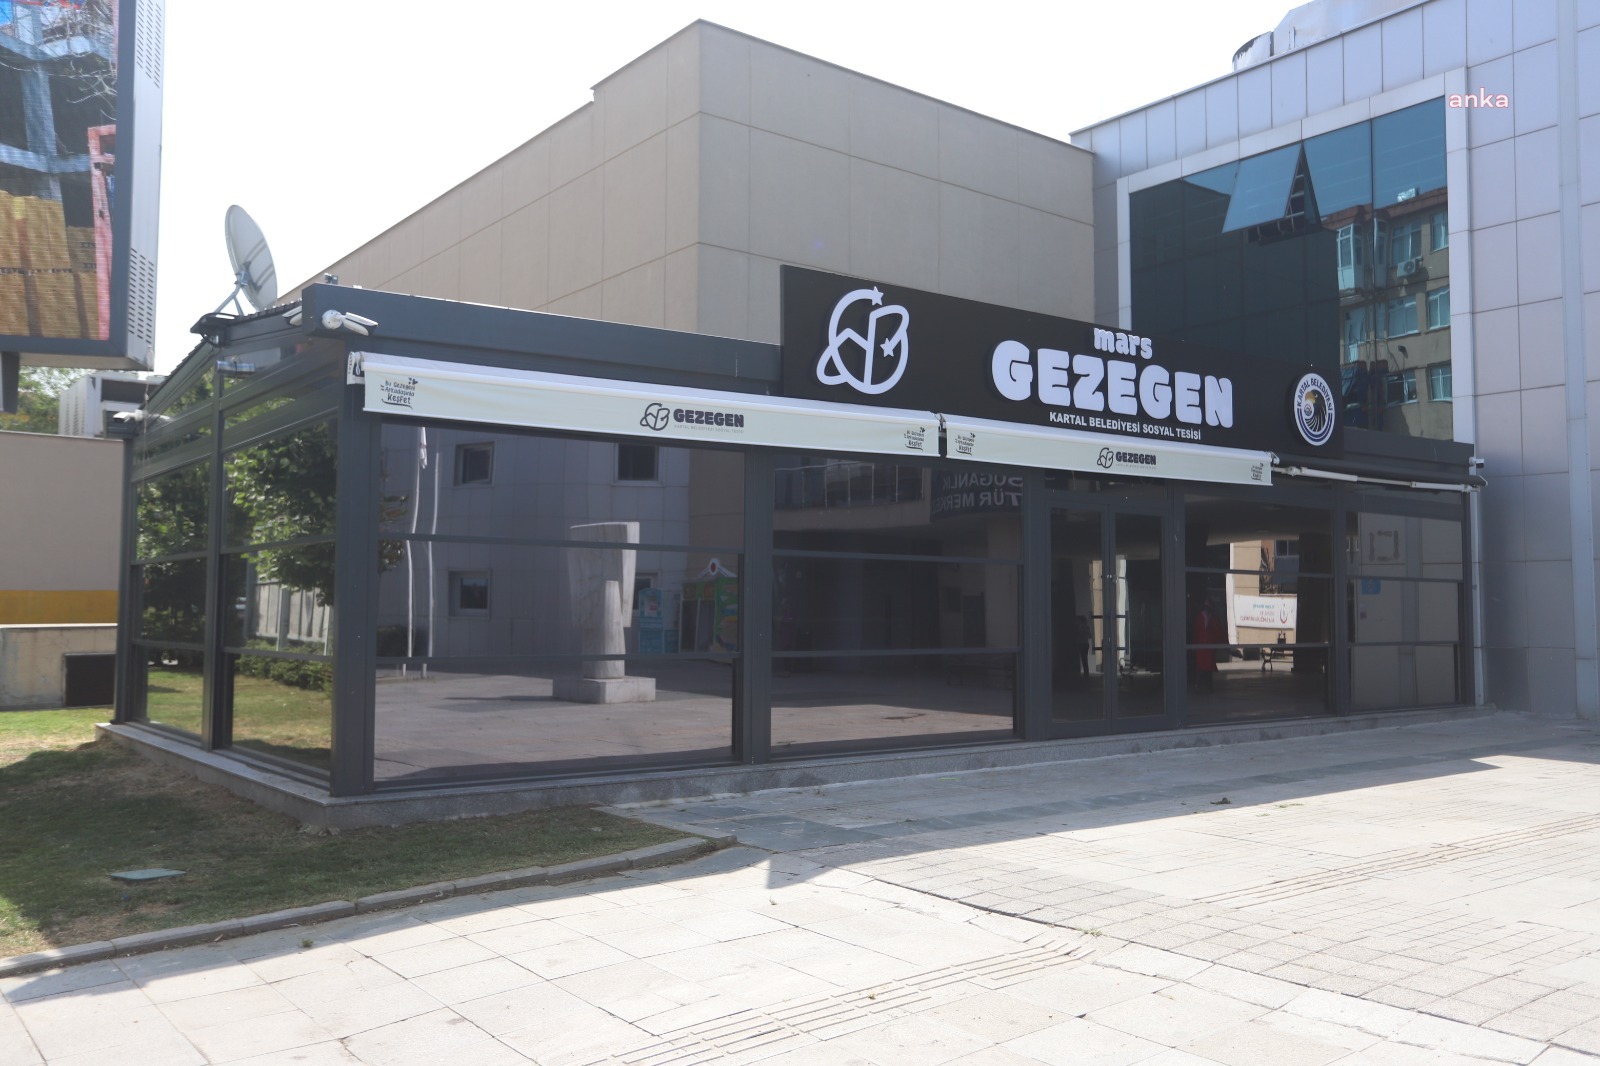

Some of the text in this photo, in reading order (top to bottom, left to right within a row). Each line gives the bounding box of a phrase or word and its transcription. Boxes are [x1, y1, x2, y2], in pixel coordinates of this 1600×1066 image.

[1094, 327, 1153, 359] mars
[991, 340, 1234, 428] GEZEGEN
[1297, 380, 1311, 407] KARTAL
[387, 393, 411, 405] Keşfet
[673, 408, 745, 428] GEZEGEN
[1050, 411, 1201, 440] KARTAL BELEDİYESİ SOSYAL TESİSİ
[1115, 451, 1157, 466] GEZEGEN
